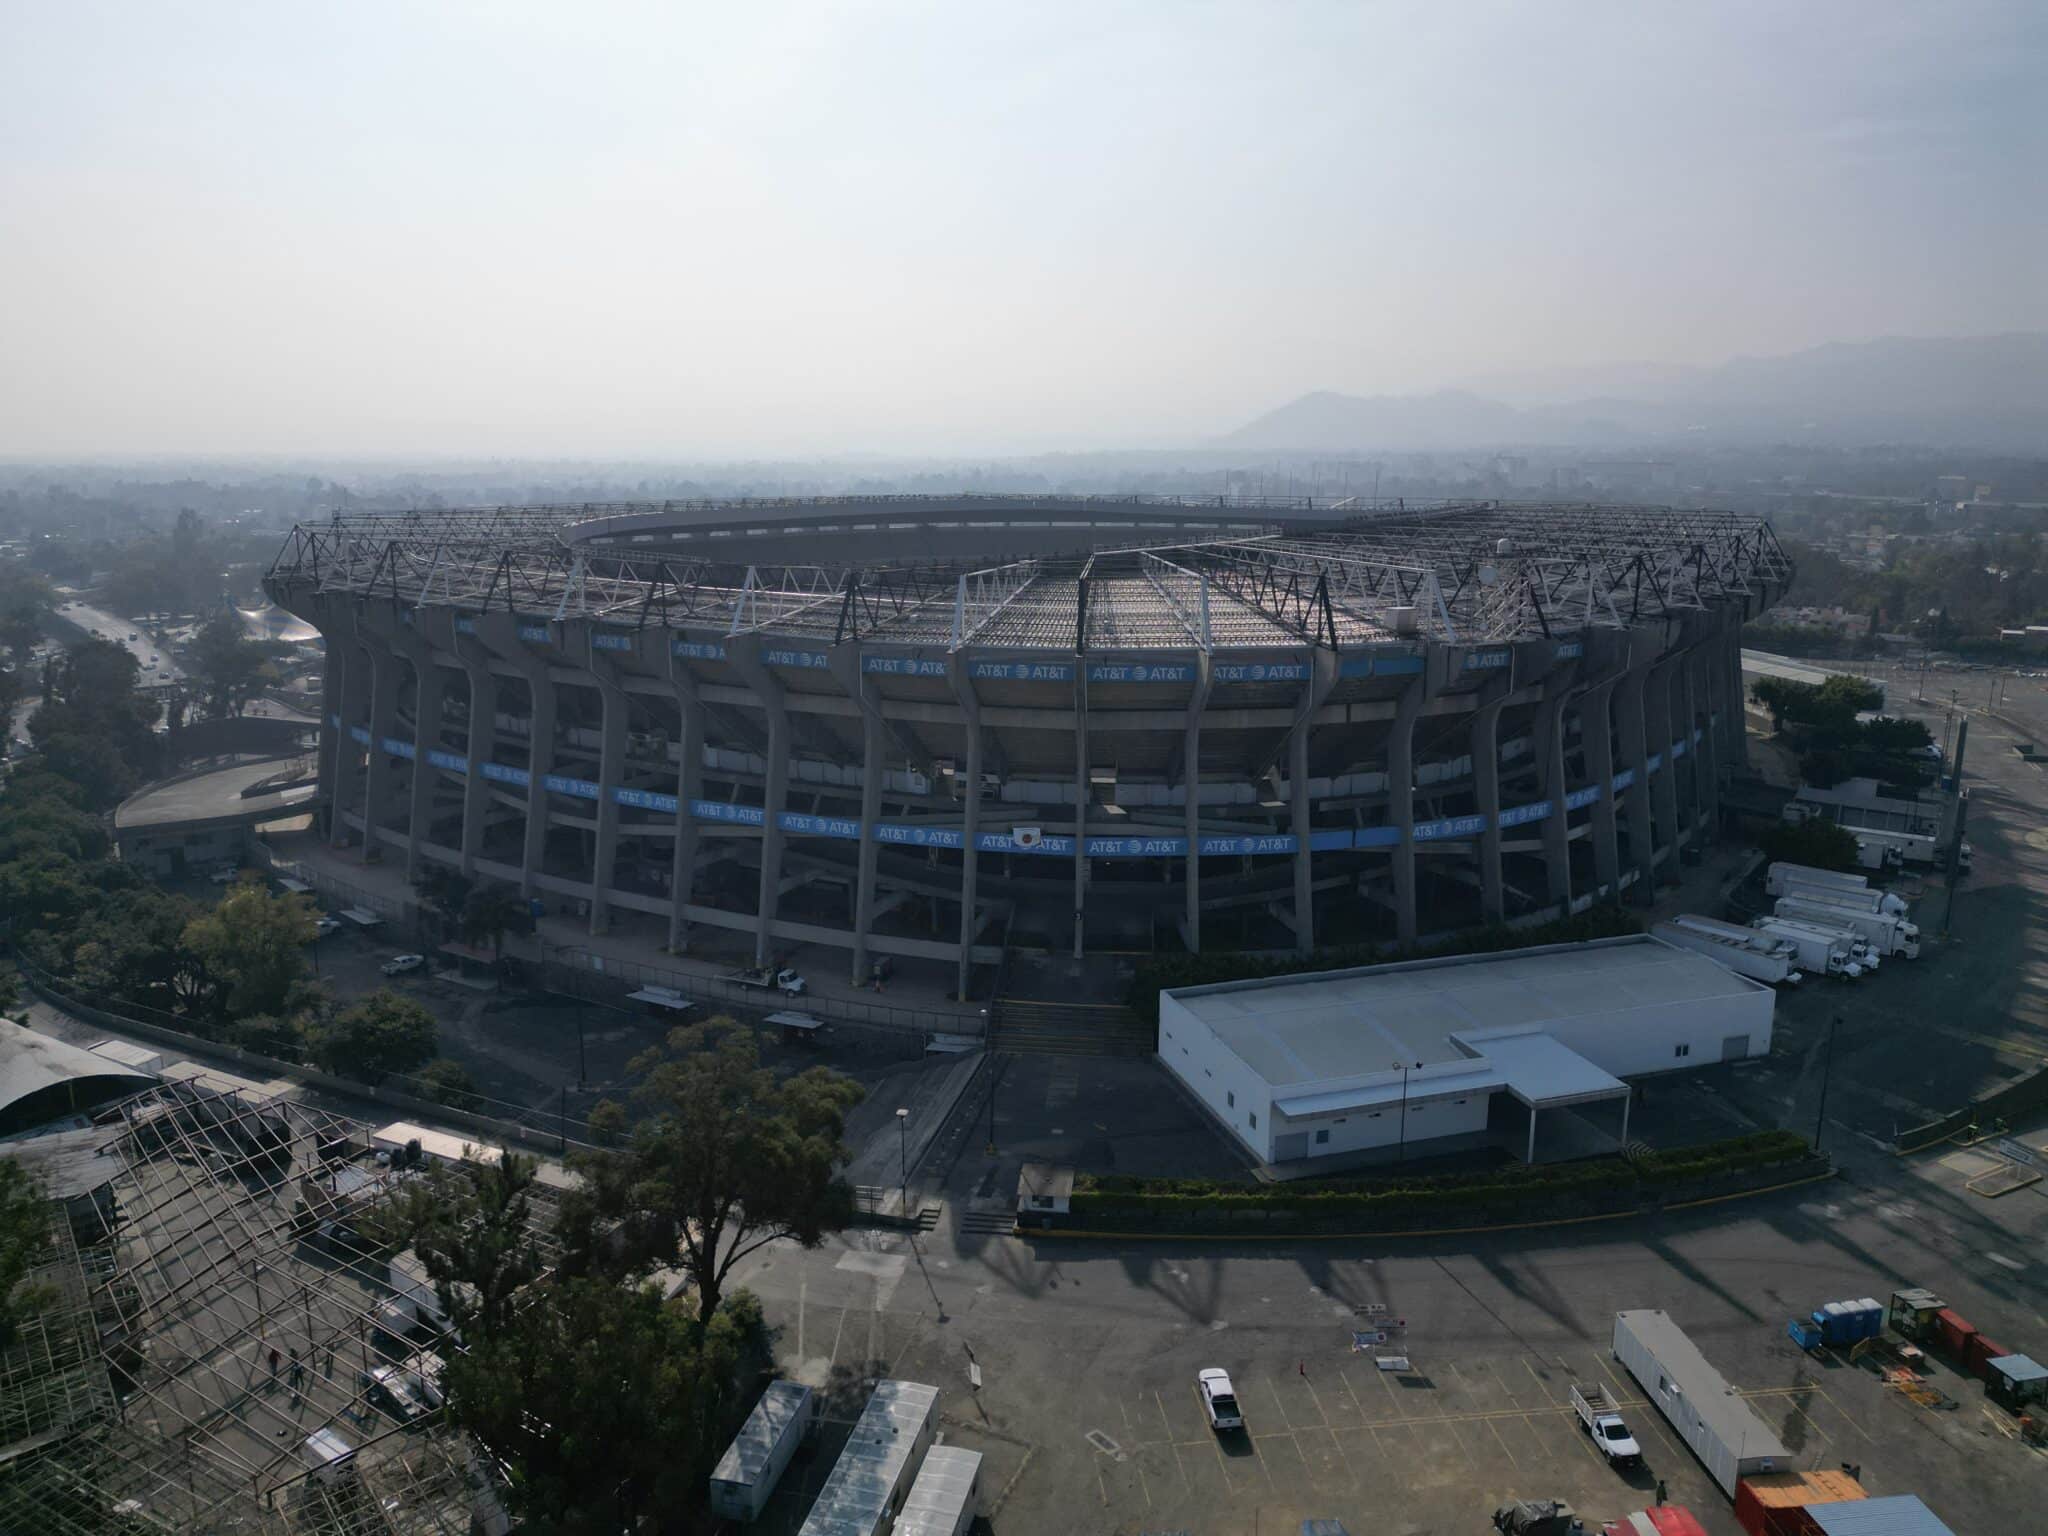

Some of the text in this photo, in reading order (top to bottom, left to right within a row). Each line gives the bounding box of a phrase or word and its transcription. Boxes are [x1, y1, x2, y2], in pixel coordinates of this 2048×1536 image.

[678, 642, 702, 657] AT&T
[768, 651, 796, 665] AT&T
[868, 658, 946, 674] AT&T AT&
[1480, 653, 1506, 667] AT&T
[976, 664, 1067, 679] AT&T AT&T
[1093, 667, 1185, 680] AT&T AT&T
[1215, 665, 1303, 679] AT&T AT&T
[617, 791, 678, 810] AT&T AT&T
[697, 804, 763, 822] AT&T AT&T
[784, 815, 857, 835] AT&T AT&T
[1414, 817, 1481, 838] AT&T AT&T
[880, 827, 960, 845] AT&T AT&T
[982, 835, 1068, 851] AT&T AT&T
[1089, 839, 1179, 853] AT&T AT&T
[1204, 837, 1292, 853] AT&T AT&T
